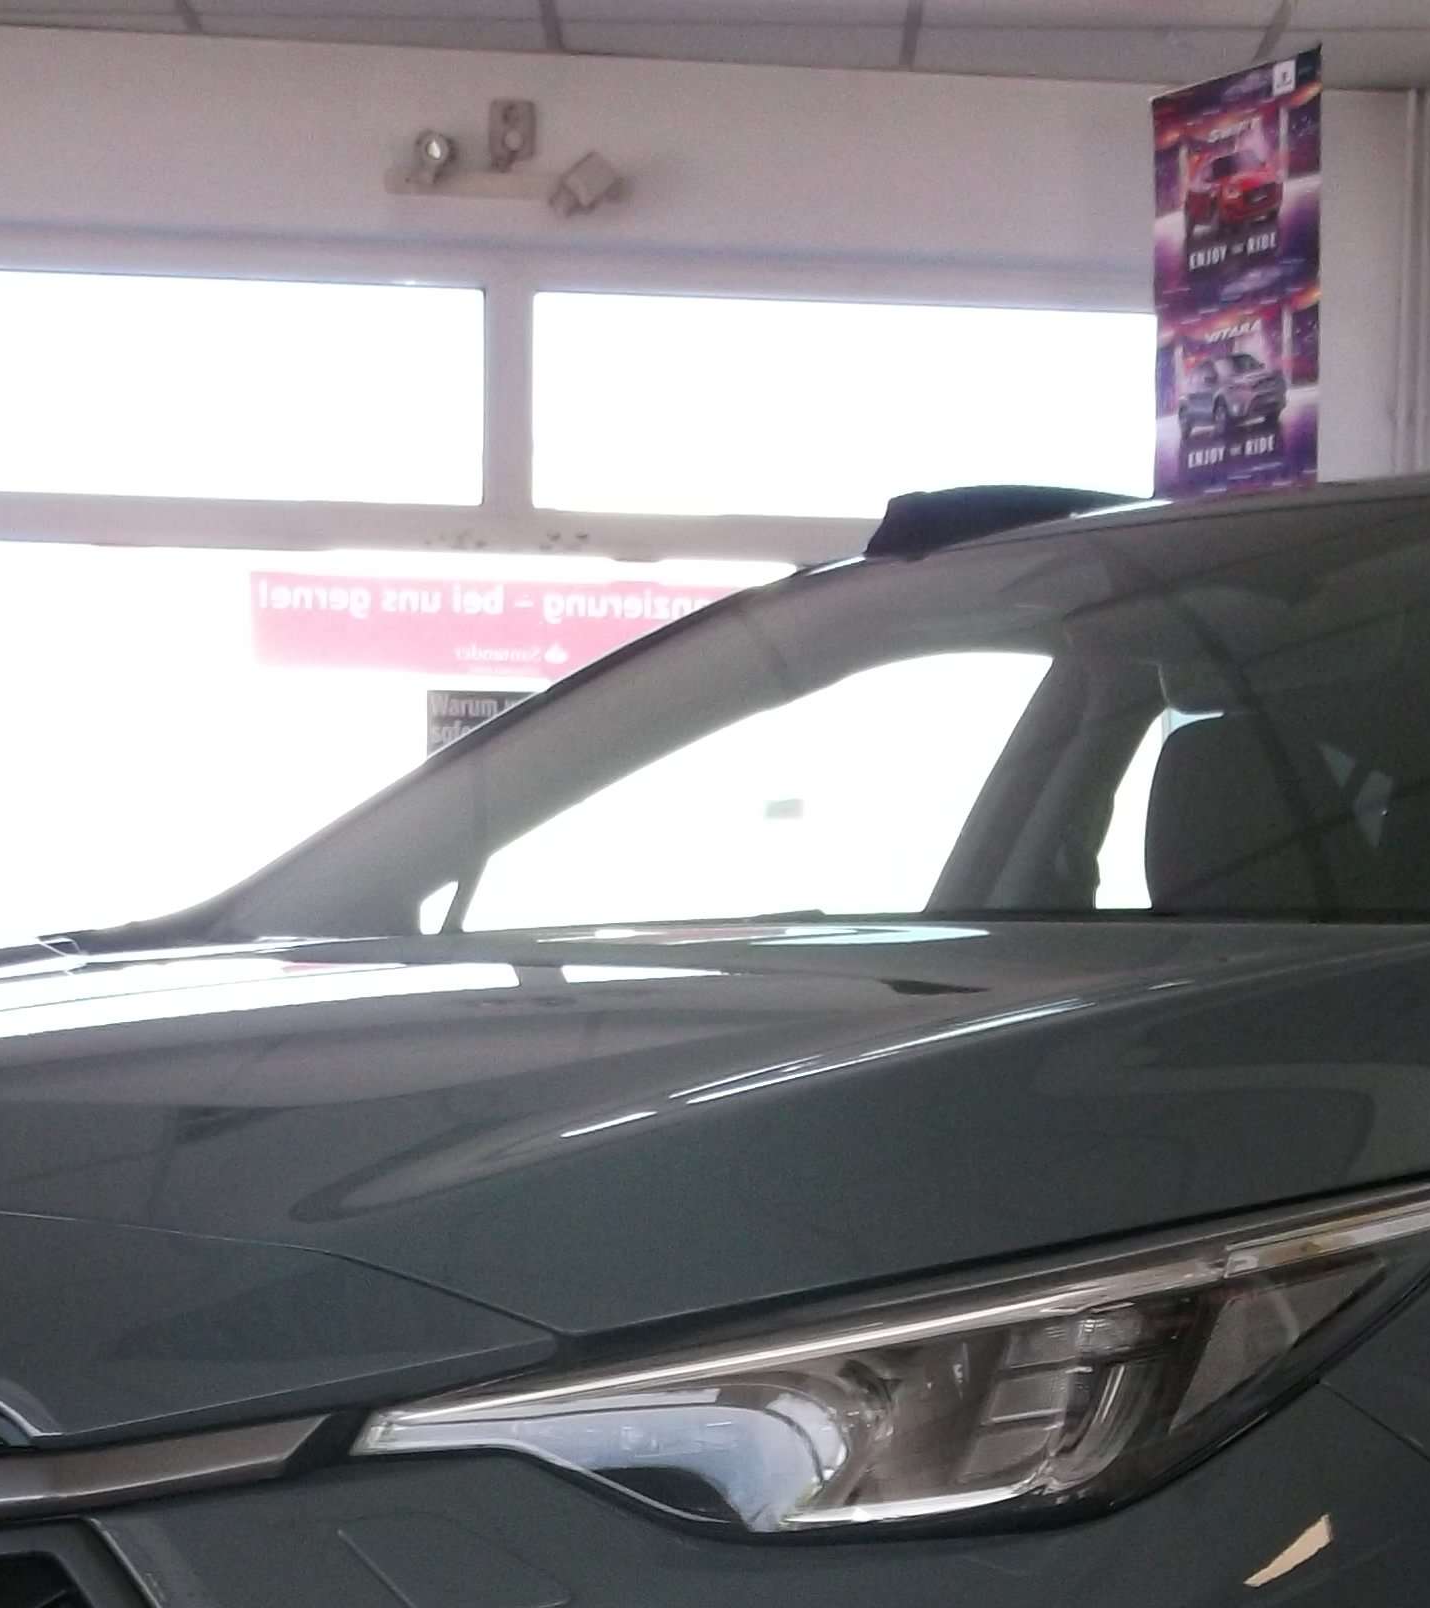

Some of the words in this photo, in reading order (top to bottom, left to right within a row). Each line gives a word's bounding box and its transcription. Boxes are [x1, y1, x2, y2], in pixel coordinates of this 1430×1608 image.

[1189, 245, 1227, 271] ENJOY
[1247, 232, 1276, 256] RIDE
[1188, 446, 1226, 469] ENJOY
[1245, 433, 1275, 456] RIDE
